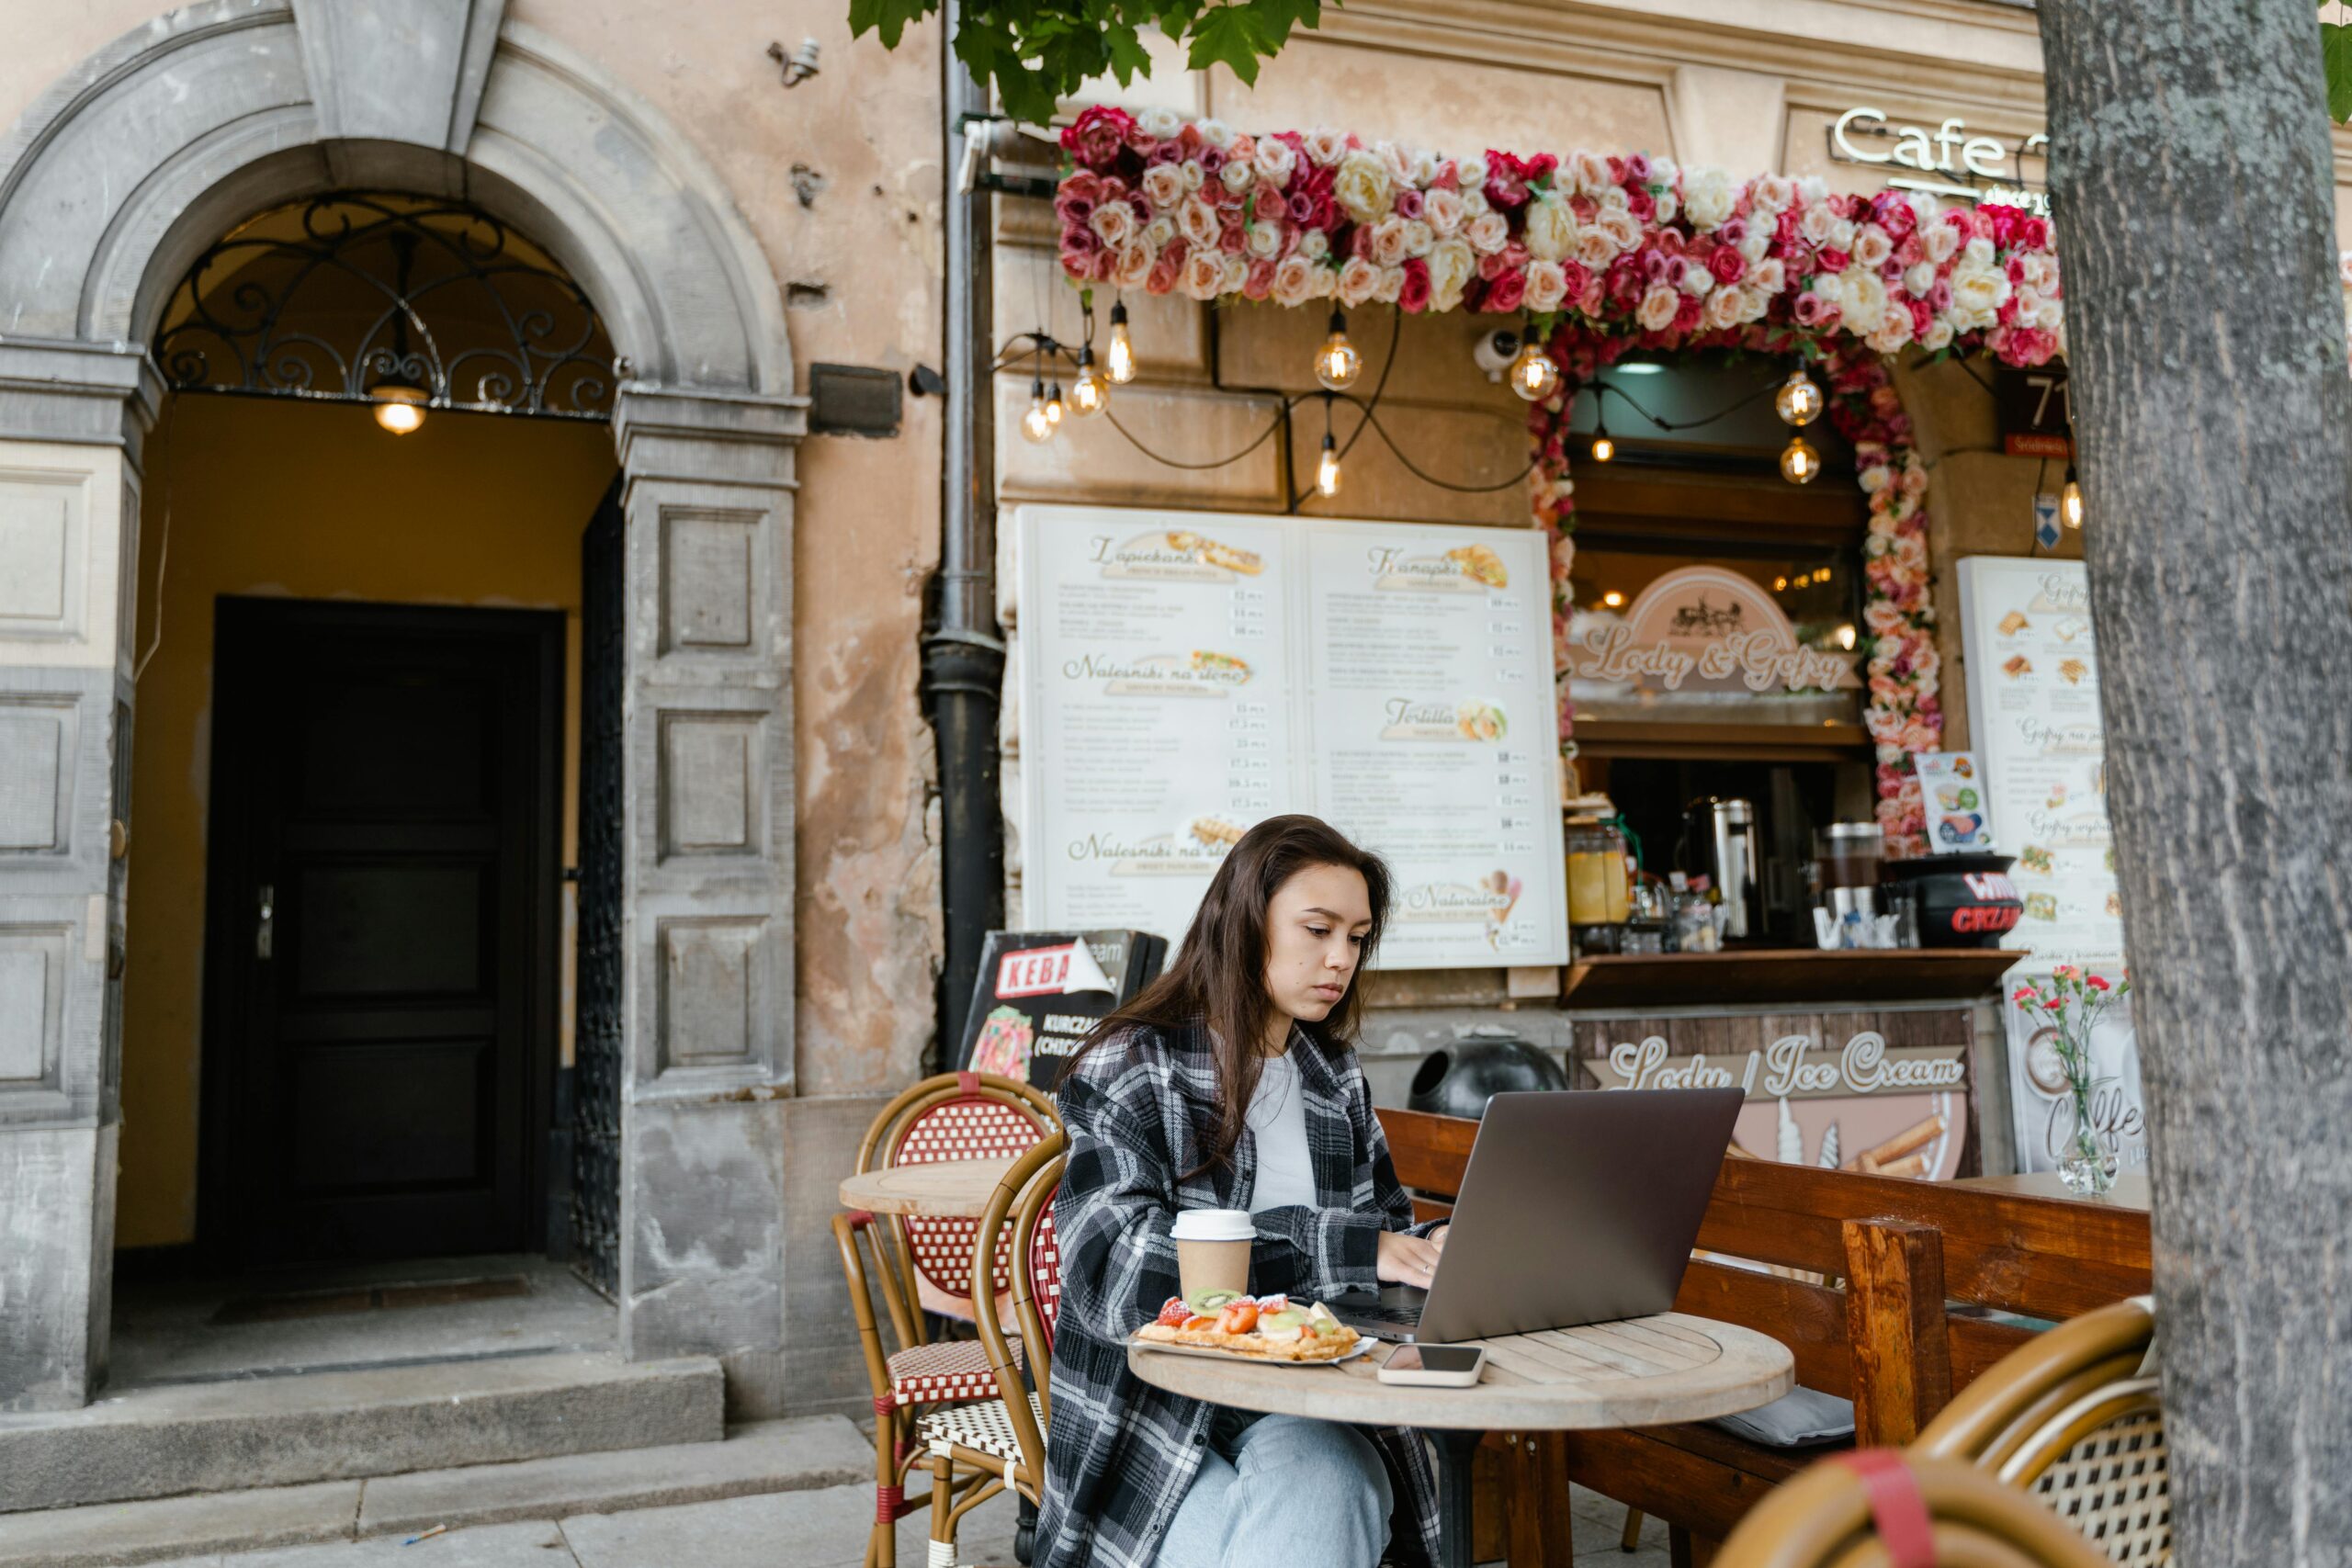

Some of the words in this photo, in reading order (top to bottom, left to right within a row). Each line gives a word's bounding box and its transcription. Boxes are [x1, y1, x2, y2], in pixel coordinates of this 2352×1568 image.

[1835, 107, 2006, 177] Cafe
[1578, 626, 1693, 690] Lody
[1699, 643, 1736, 679] &
[1726, 628, 1849, 691] Gofry
[1385, 697, 1455, 727] Tortilla
[1008, 954, 1070, 988] KEBA
[1609, 1036, 1733, 1090] Lody
[1764, 1035, 1840, 1097] Ice
[1840, 1031, 1965, 1093] Cream
